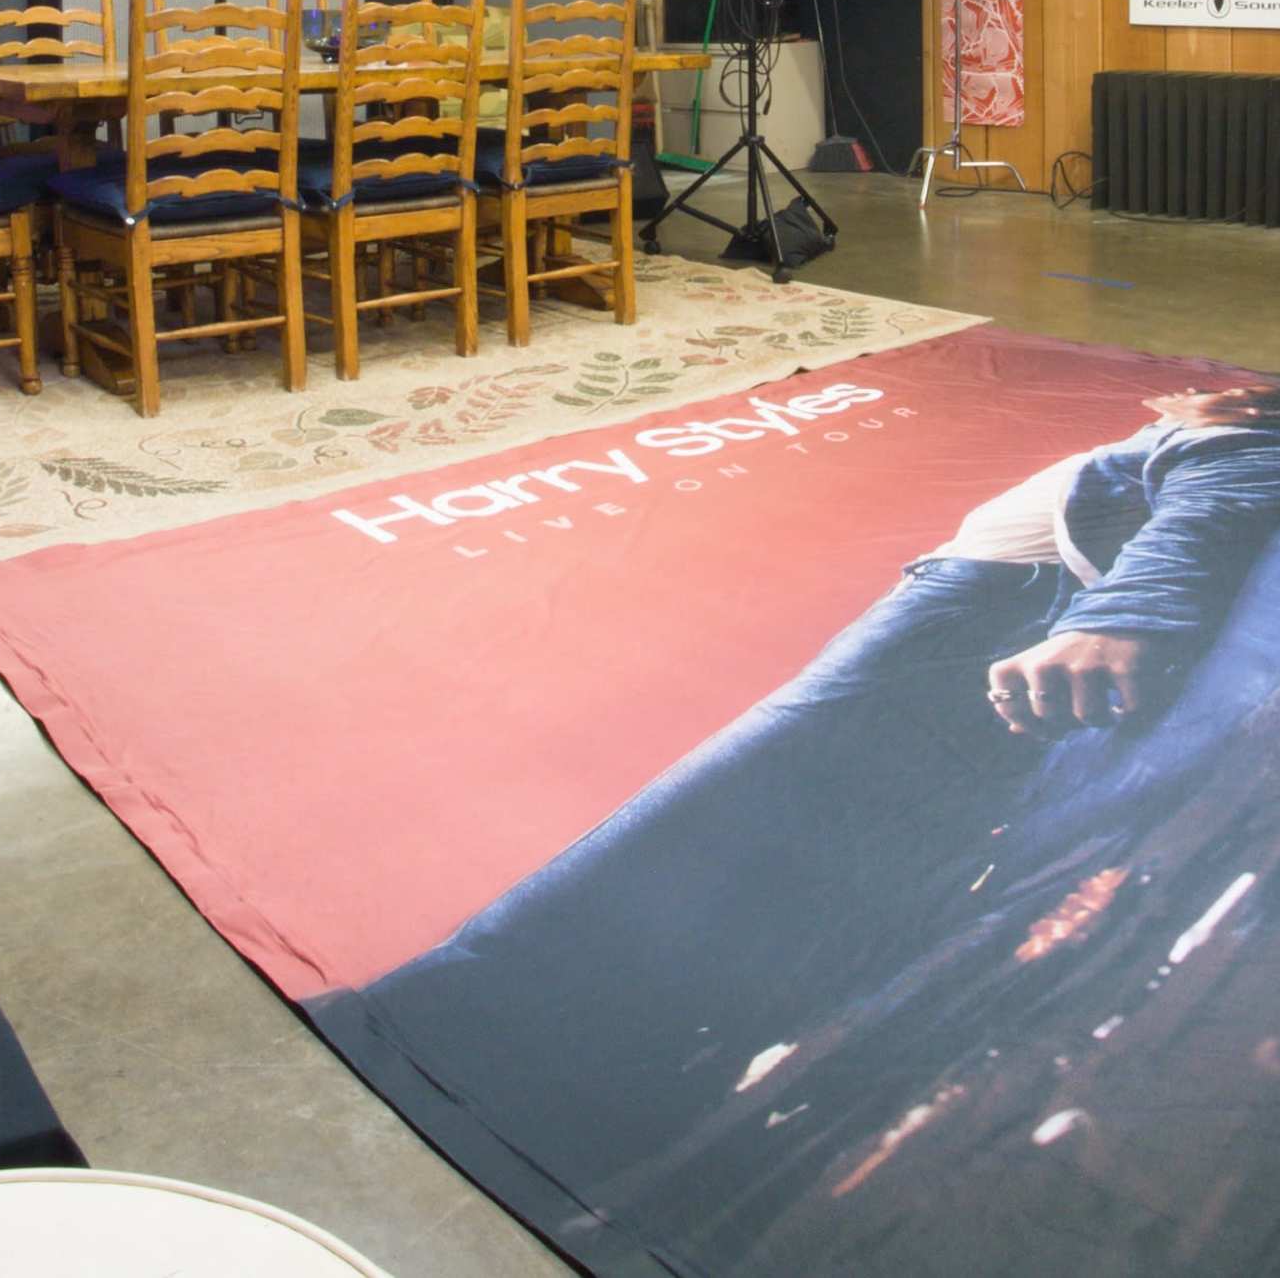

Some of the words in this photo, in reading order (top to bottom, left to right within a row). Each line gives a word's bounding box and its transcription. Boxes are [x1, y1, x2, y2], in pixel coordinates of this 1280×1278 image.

[331, 449, 649, 543] Harry
[634, 383, 884, 456] Styles
[452, 502, 627, 558] LIVE
[674, 463, 749, 492] ON
[786, 407, 919, 455] TOUR
